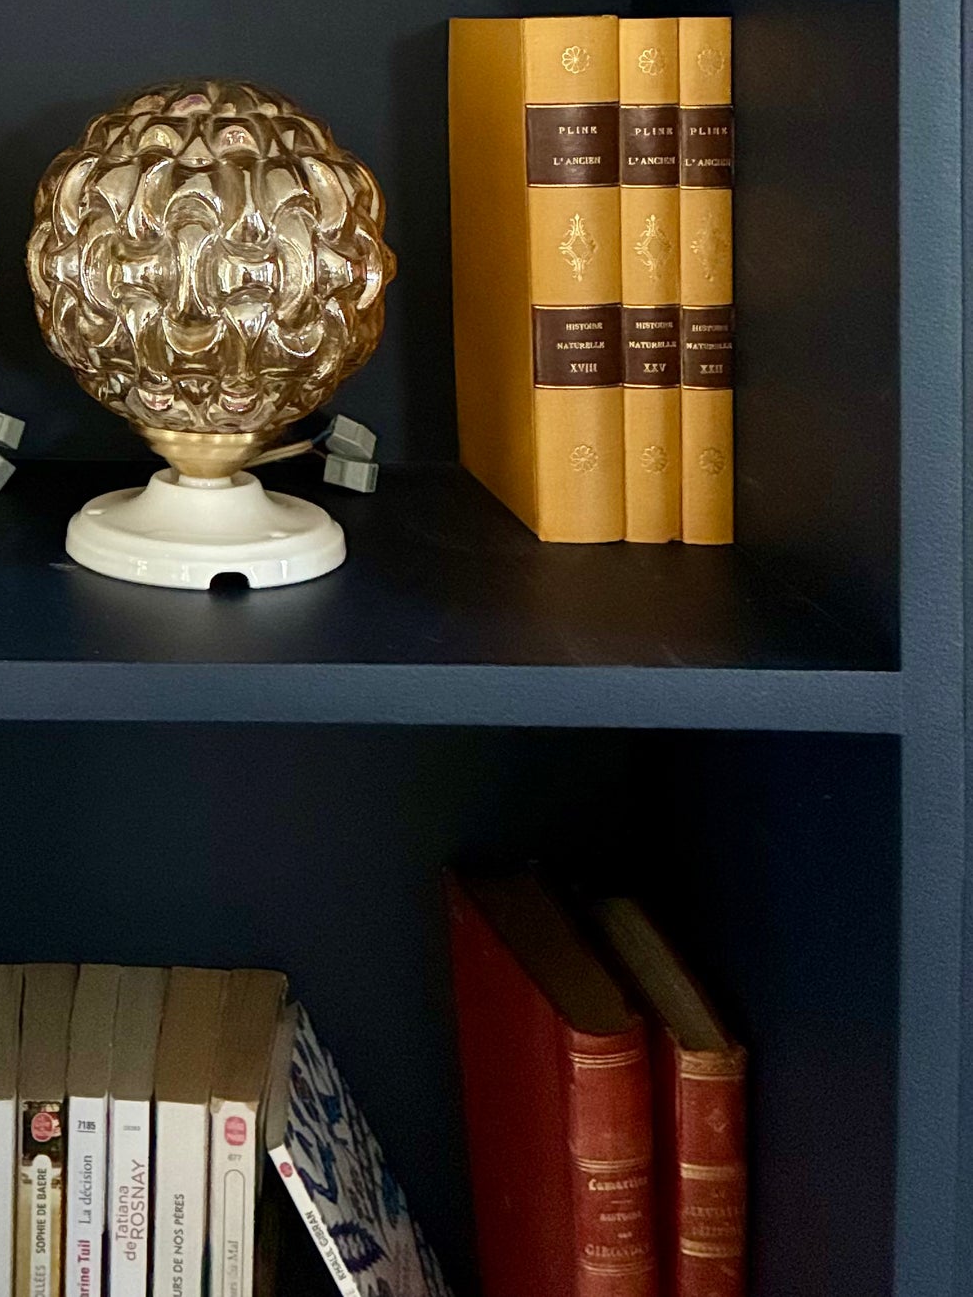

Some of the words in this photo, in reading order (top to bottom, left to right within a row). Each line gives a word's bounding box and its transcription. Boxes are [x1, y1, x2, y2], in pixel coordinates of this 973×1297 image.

[558, 126, 598, 135] PLINE
[634, 127, 674, 136] PLINE
[565, 322, 604, 331] HISTOIRE
[557, 341, 605, 350] NATURELLE
[628, 340, 677, 349] NATURELLE
[569, 363, 598, 373] XVIII
[643, 362, 667, 373] XXV
[37, 1168, 47, 1200] BAERE
[78, 1155, 93, 1206] décision
[37, 1203, 47, 1215] DE
[115, 1185, 129, 1241] Tatiana
[123, 1242, 137, 1261] de
[130, 1159, 146, 1240] ROSNAY
[79, 1212, 92, 1224] La
[35, 1219, 46, 1254] SOPHIE
[173, 1229, 184, 1255] NOS
[77, 1239, 91, 1263] Tuil
[172, 1258, 184, 1273] DE
